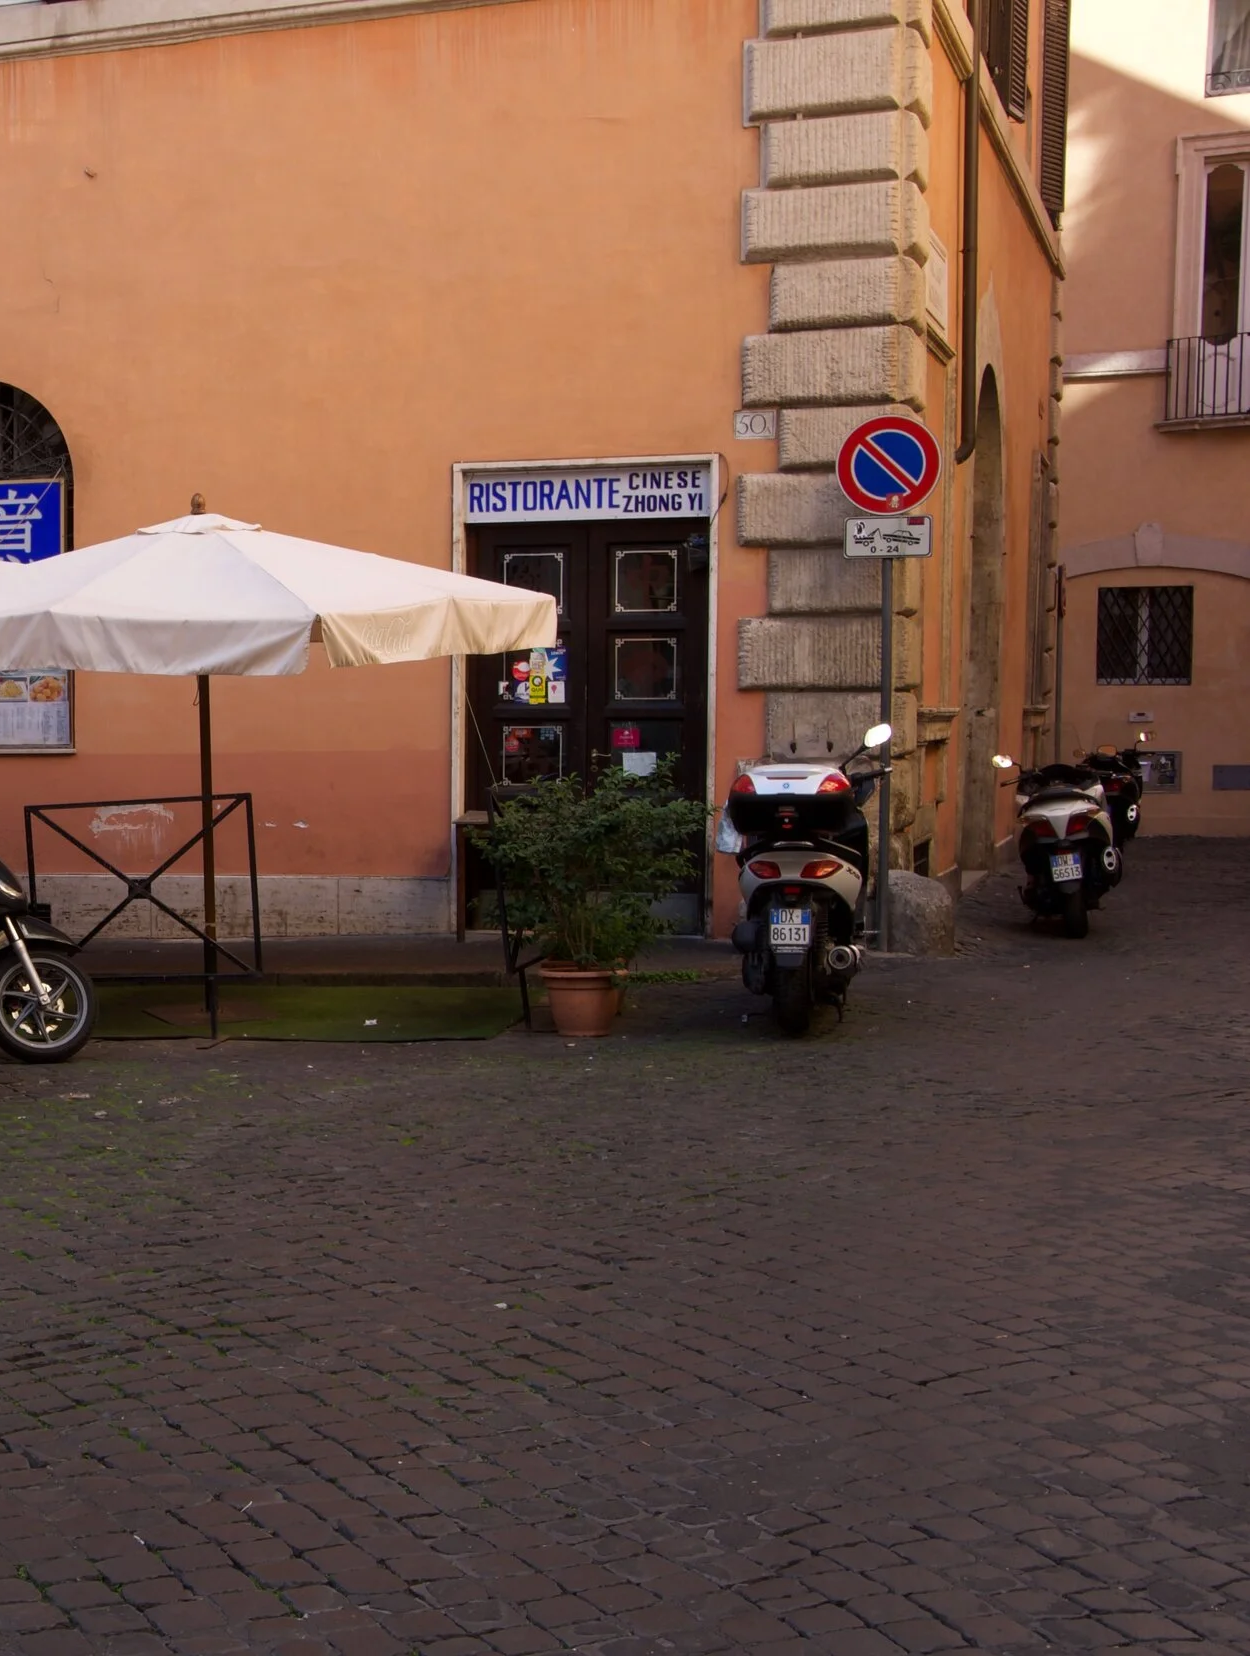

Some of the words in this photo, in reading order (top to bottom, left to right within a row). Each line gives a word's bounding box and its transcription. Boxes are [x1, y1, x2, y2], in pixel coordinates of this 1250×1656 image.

[628, 470, 702, 490] CINESE
[469, 478, 621, 513] RISTORANTE
[622, 494, 682, 513] ZHONG
[688, 493, 703, 511] YI
[870, 546, 876, 554] 0
[887, 545, 899, 553] 24
[1053, 866, 1081, 879] 56513
[781, 909, 794, 923] DX
[772, 927, 806, 942] 86131
